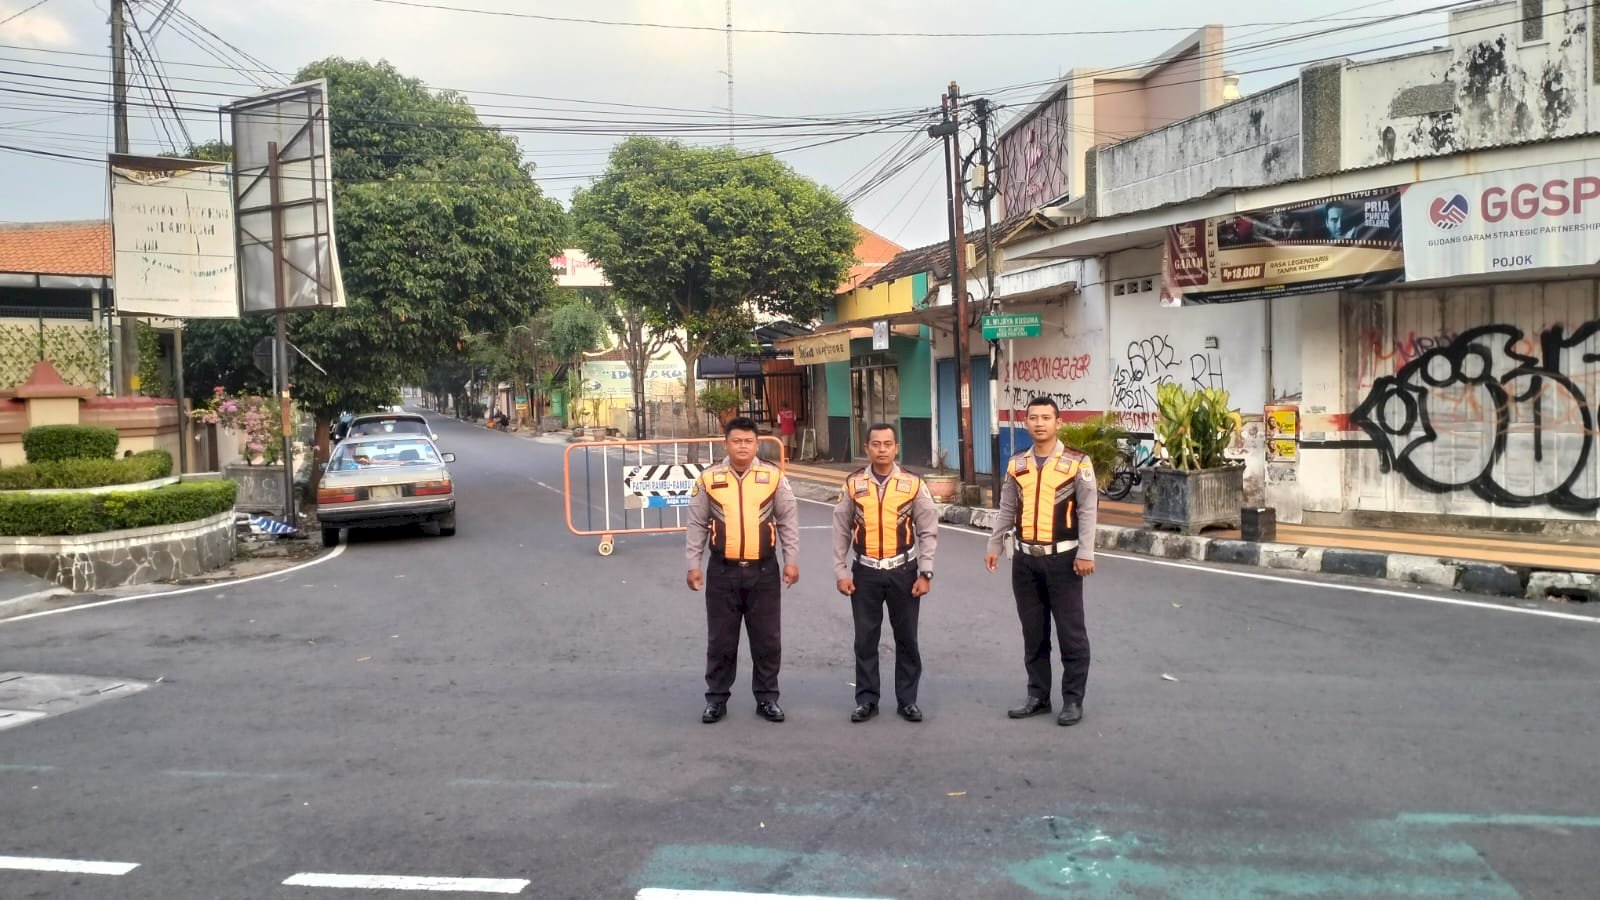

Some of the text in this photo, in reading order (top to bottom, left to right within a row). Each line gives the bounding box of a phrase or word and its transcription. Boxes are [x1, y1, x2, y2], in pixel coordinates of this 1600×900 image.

[1364, 200, 1390, 212] PRIA
[1480, 176, 1600, 223] GGSP
[1364, 212, 1390, 221] PUNYA
[1364, 220, 1390, 229] SELERA
[1428, 221, 1600, 247] GUDANG GARAM STRATEGIC PARTNERSHIP
[1174, 256, 1204, 270] GARAM
[1270, 254, 1329, 269] RASA LEGENDARIS
[1492, 255, 1533, 268] POJOK
[1276, 263, 1320, 275] TANPA FILTER
[1190, 351, 1224, 394] RH
